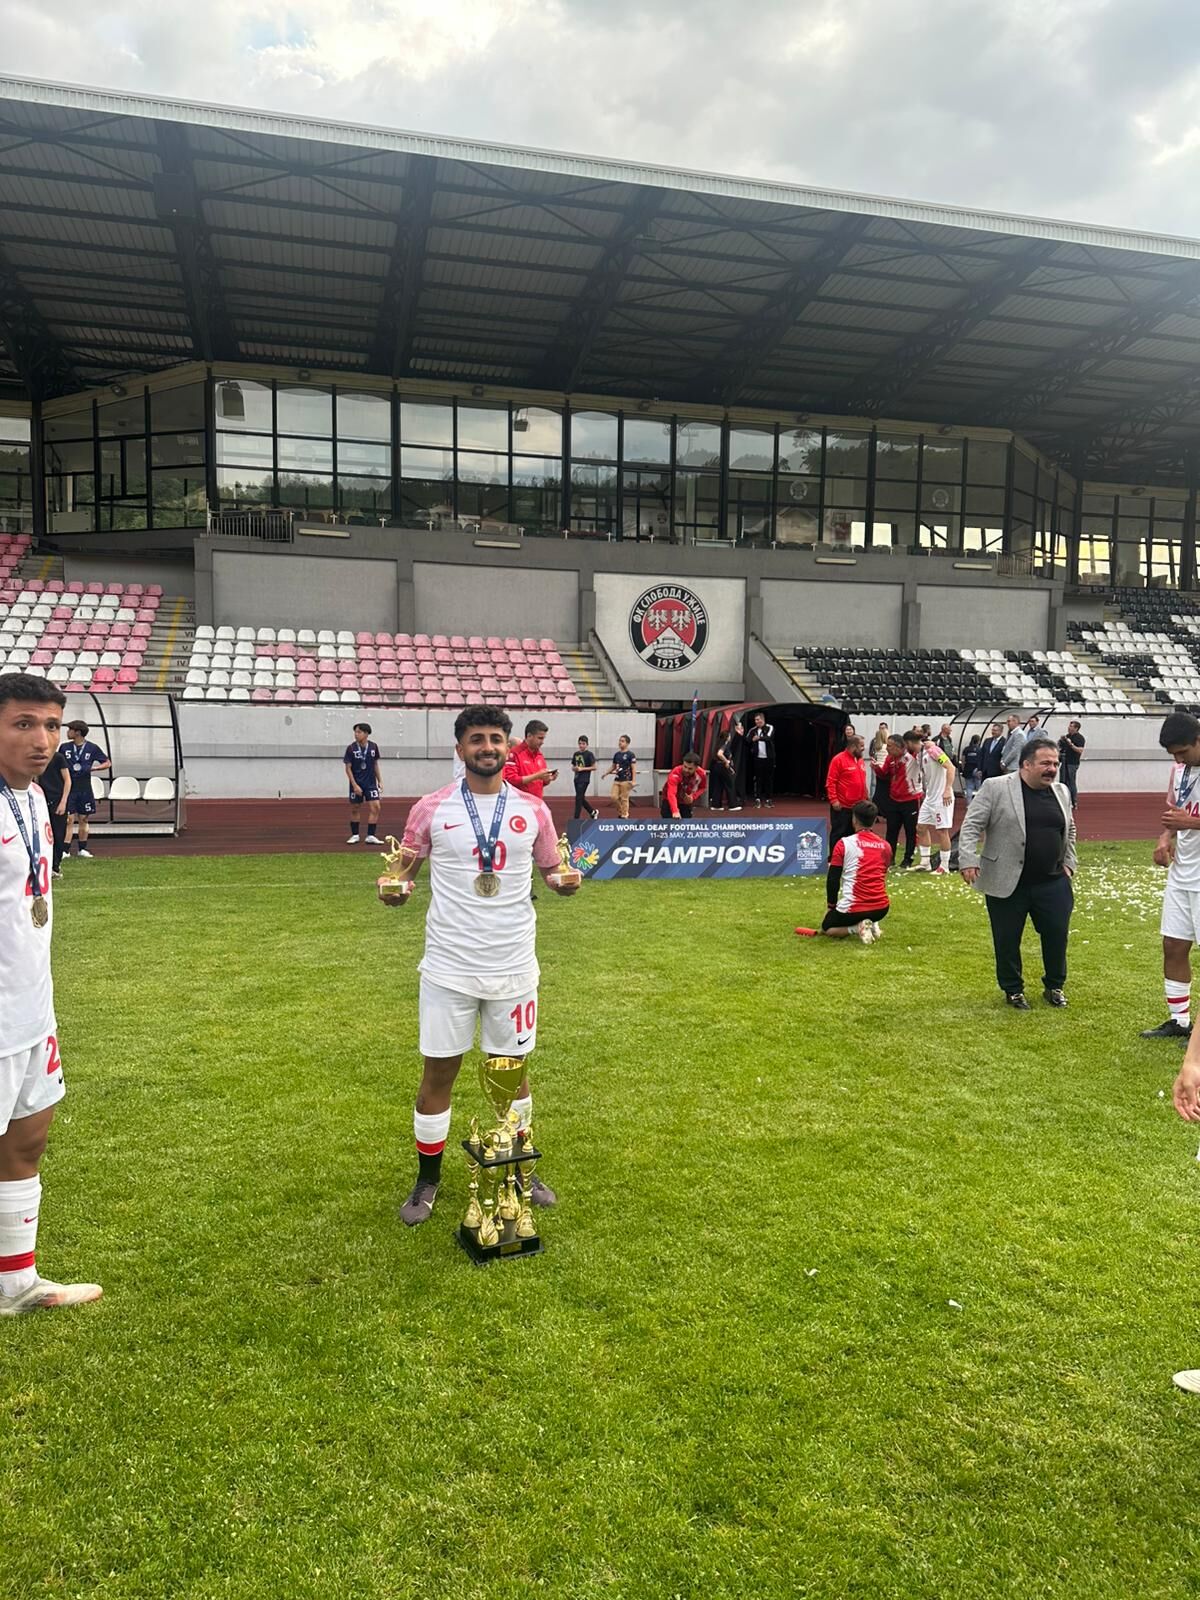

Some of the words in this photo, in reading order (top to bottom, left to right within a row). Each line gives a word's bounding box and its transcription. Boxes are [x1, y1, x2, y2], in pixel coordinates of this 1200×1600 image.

[632, 608, 646, 623] ФК
[641, 587, 682, 608] СЛОБОДА
[682, 592, 706, 625] УЖИЦЕ
[657, 658, 680, 668] 1925
[65, 750, 71, 759] 5
[370, 790, 378, 798] 13
[85, 803, 91, 812] 5
[936, 813, 942, 823] 5
[647, 823, 668, 831] DEAF
[670, 823, 709, 831] FOOTBALL
[611, 844, 786, 865] CHAMPIONS
[510, 1000, 535, 1034] 10
